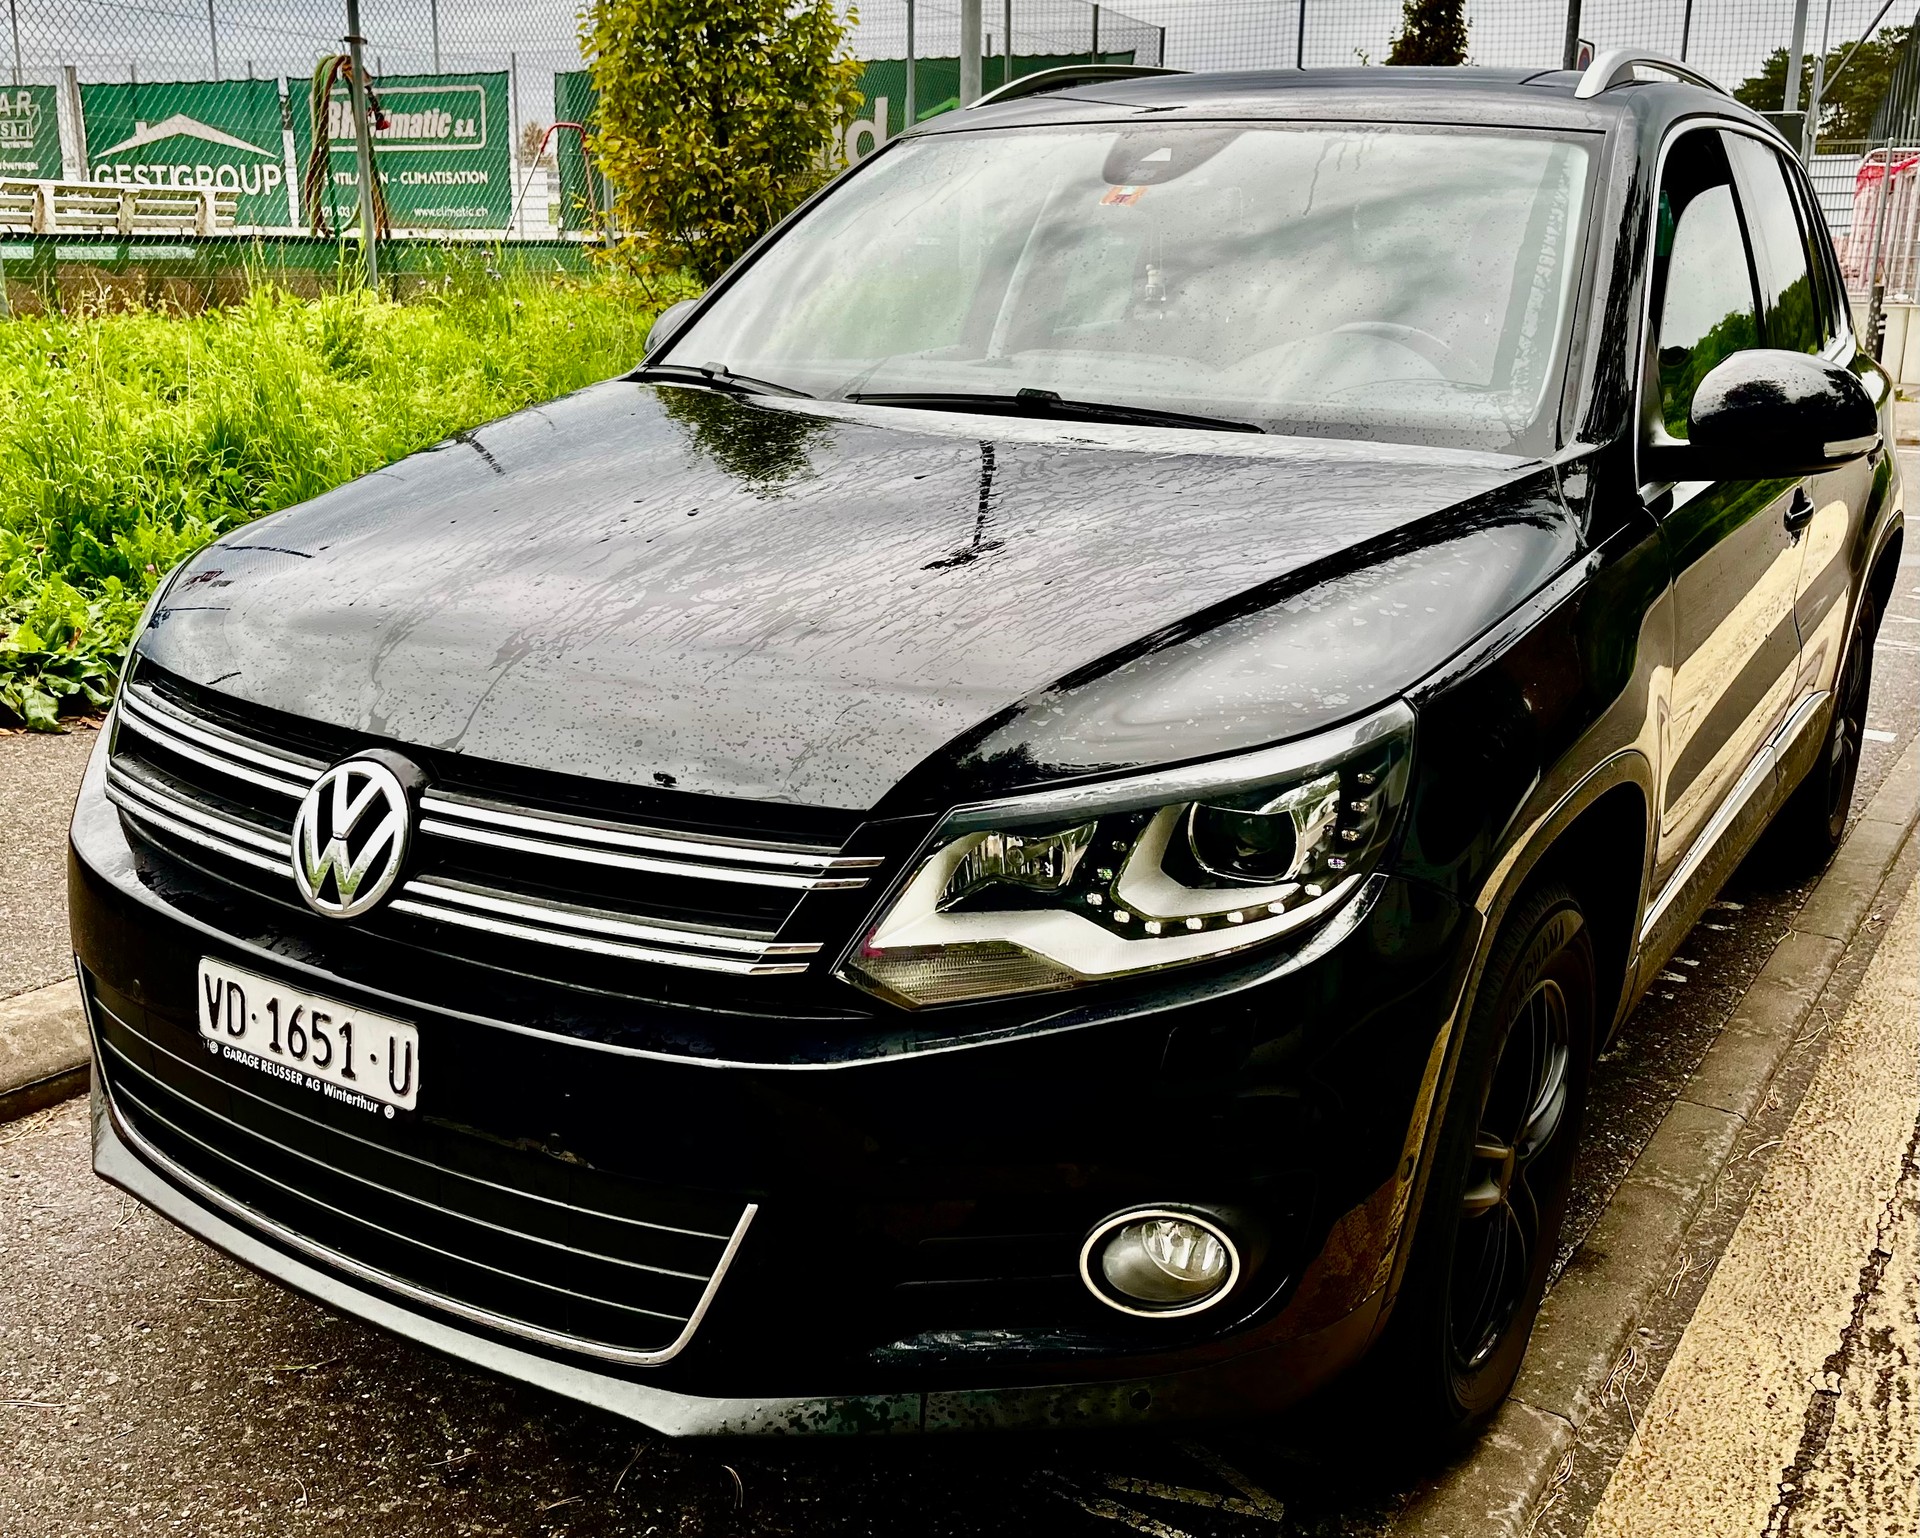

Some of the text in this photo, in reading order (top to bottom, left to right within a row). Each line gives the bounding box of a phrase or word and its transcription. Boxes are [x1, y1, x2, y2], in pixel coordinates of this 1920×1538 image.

[95, 164, 281, 195] GESTIGROUP
[400, 171, 488, 185] CLIMATISATION
[223, 1045, 379, 1114] GARAGE REUSSER AG Winterthur
